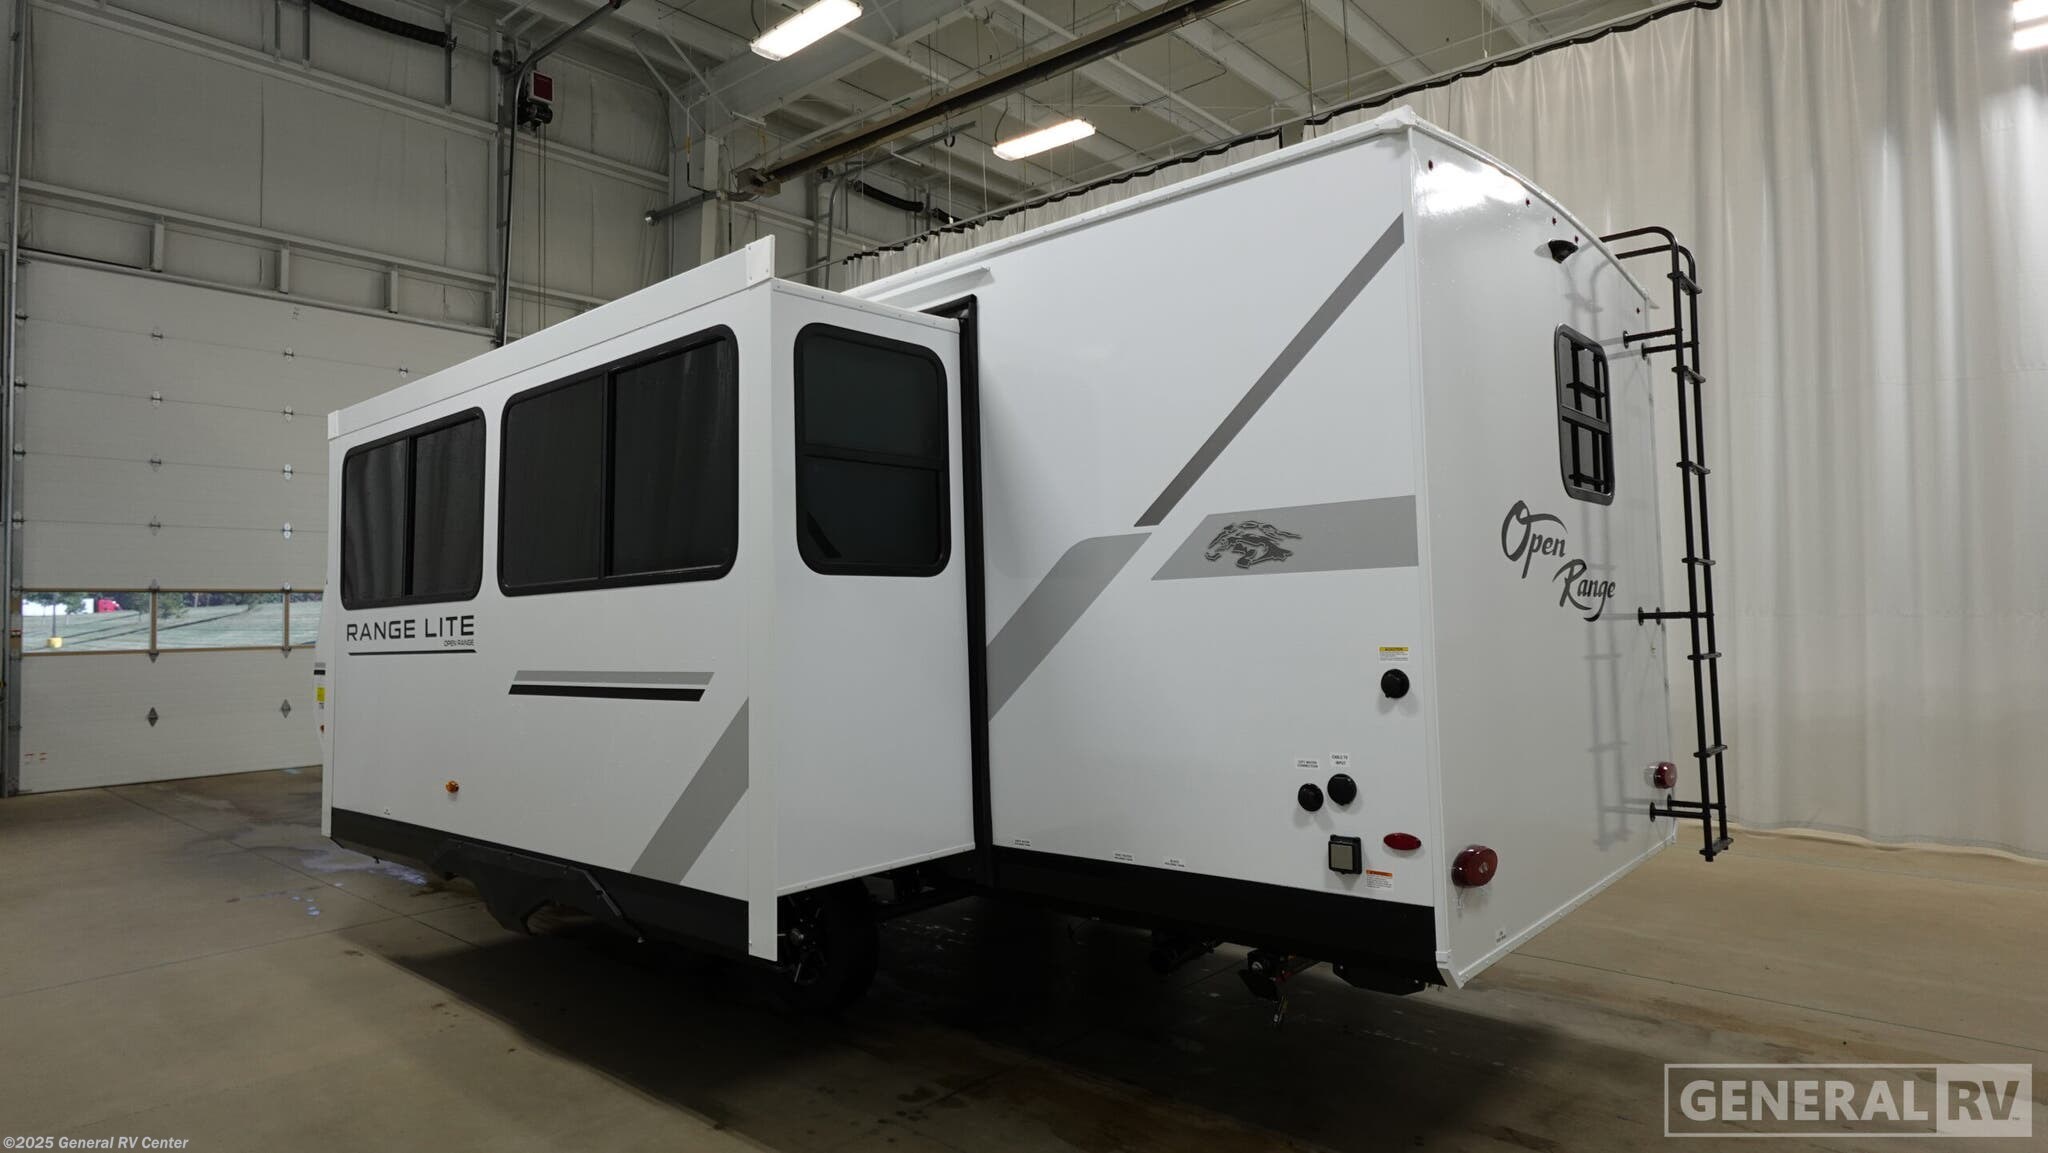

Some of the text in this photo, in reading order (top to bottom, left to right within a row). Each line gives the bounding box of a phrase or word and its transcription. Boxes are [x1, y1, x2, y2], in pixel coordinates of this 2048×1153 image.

[1501, 499, 1568, 579] Open
[1552, 558, 1616, 622] Range
[346, 615, 475, 642] RANGE LITE
